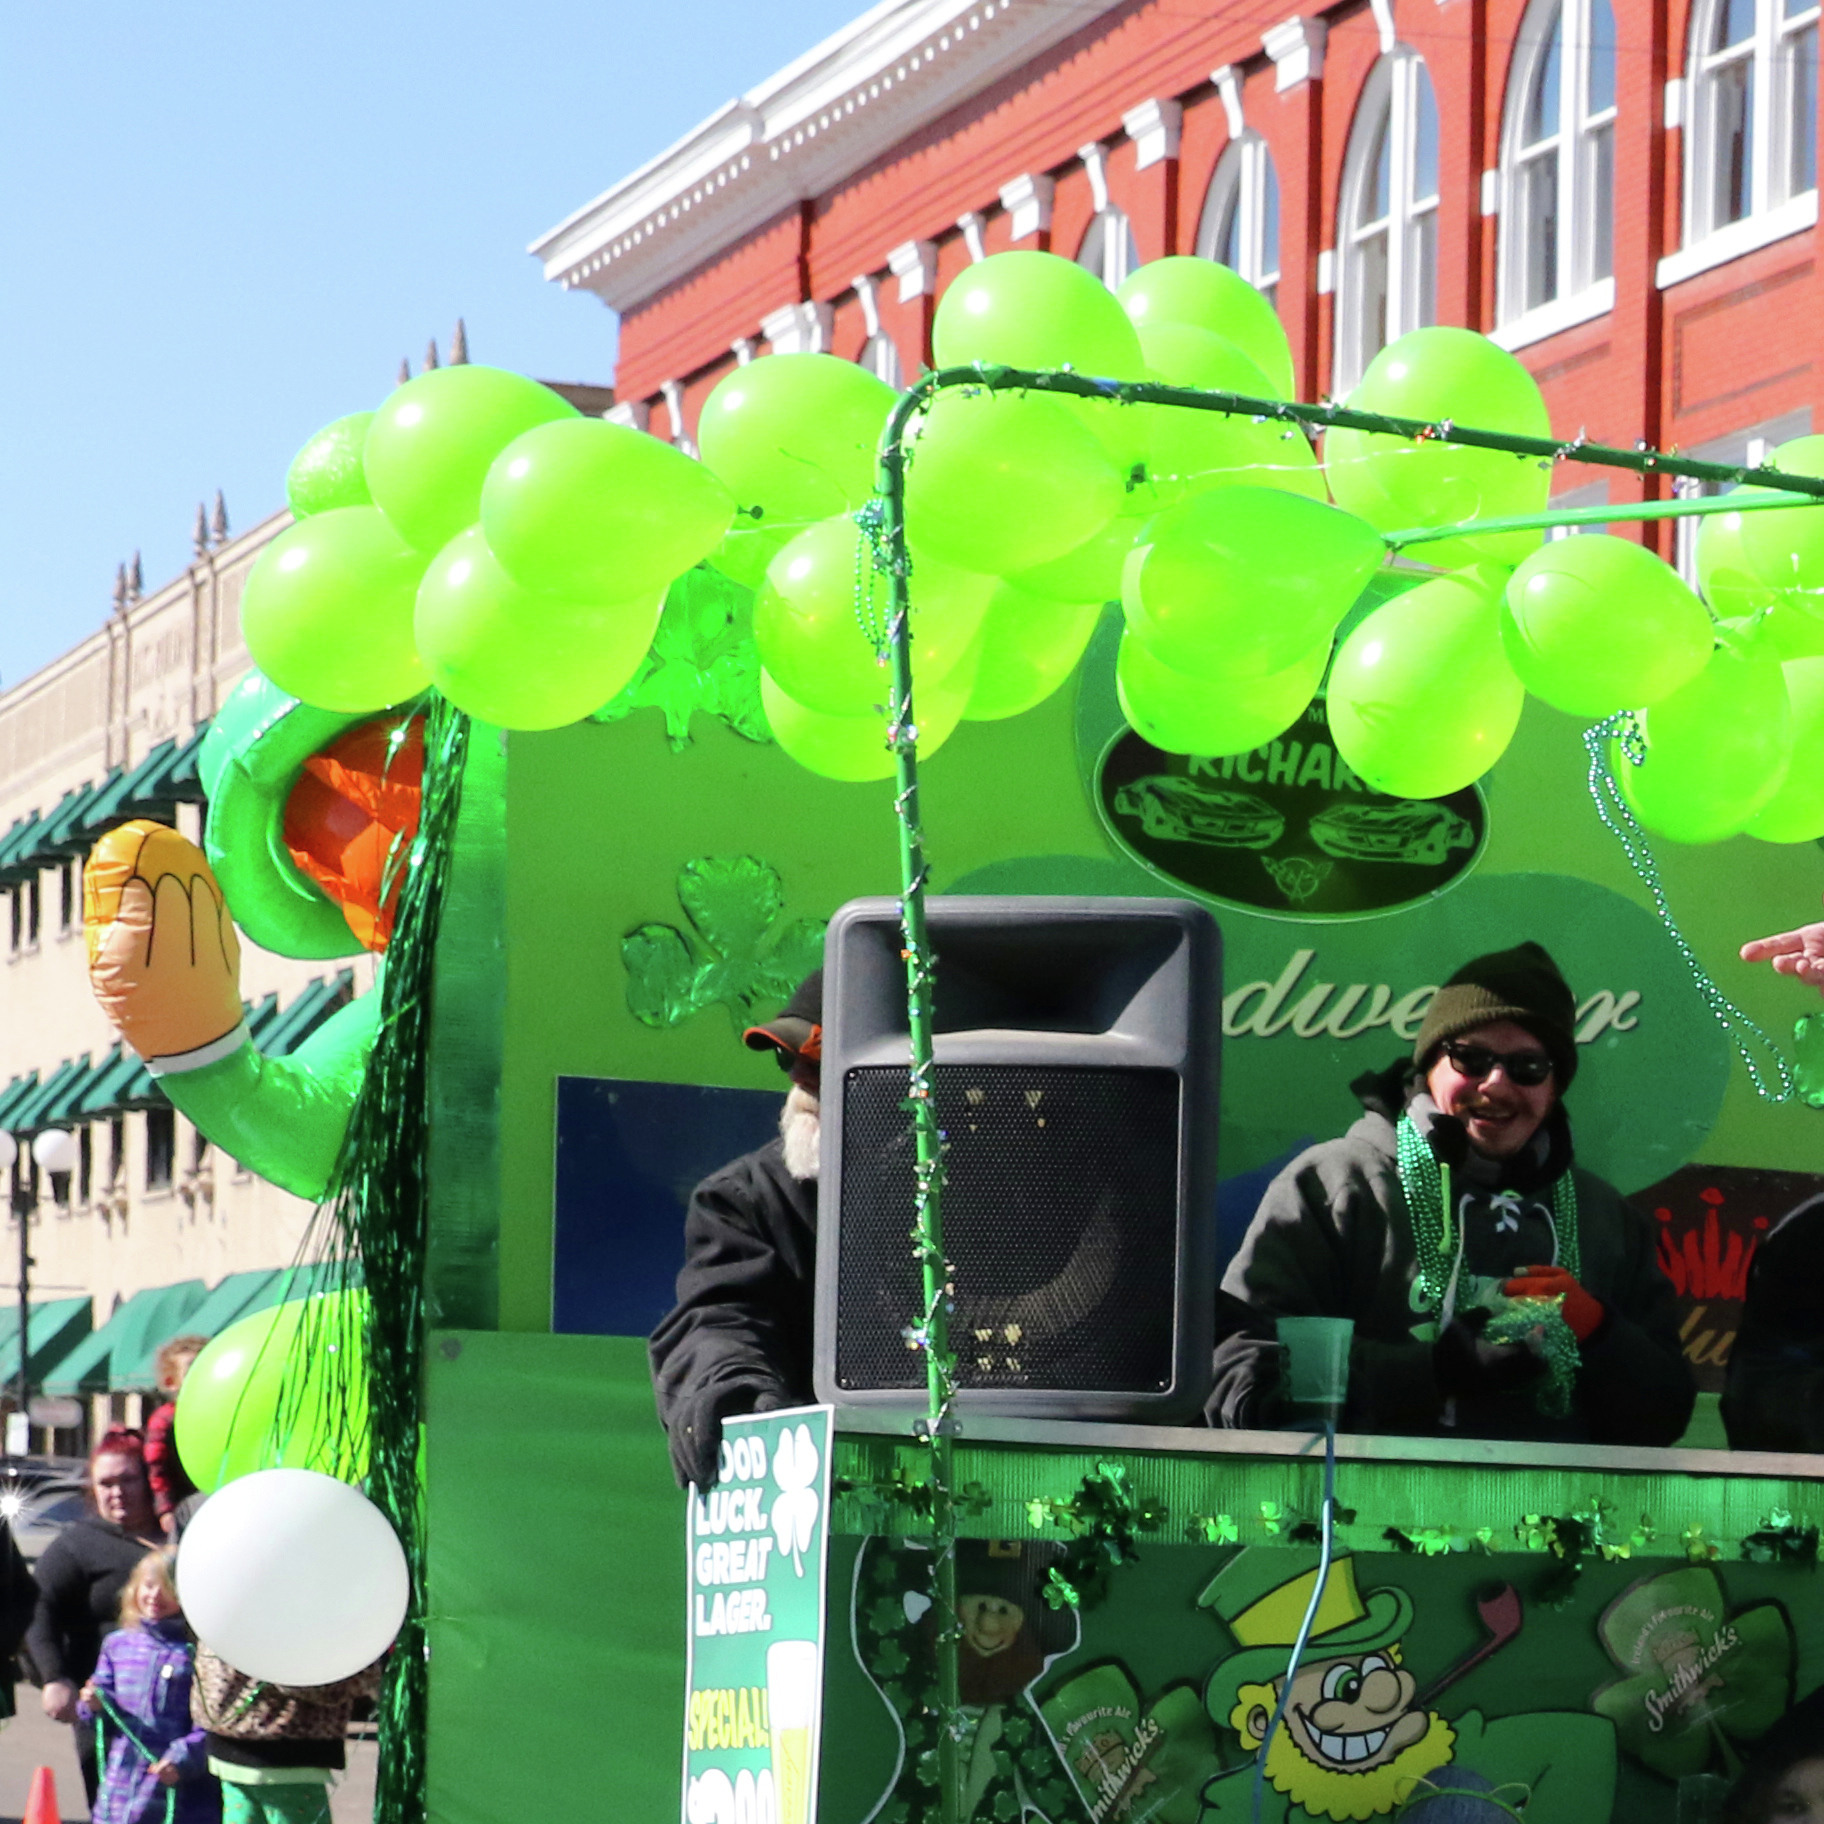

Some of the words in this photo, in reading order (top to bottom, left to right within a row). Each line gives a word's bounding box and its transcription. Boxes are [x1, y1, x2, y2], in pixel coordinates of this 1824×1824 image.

[718, 1436, 768, 1484] OOD
[696, 1487, 769, 1536] LUCK.
[696, 1536, 774, 1587] GREAT
[695, 1588, 773, 1637] LAGER.
[688, 1686, 770, 1751] SPECIAL!
[1091, 1717, 1161, 1821] mithwick's
